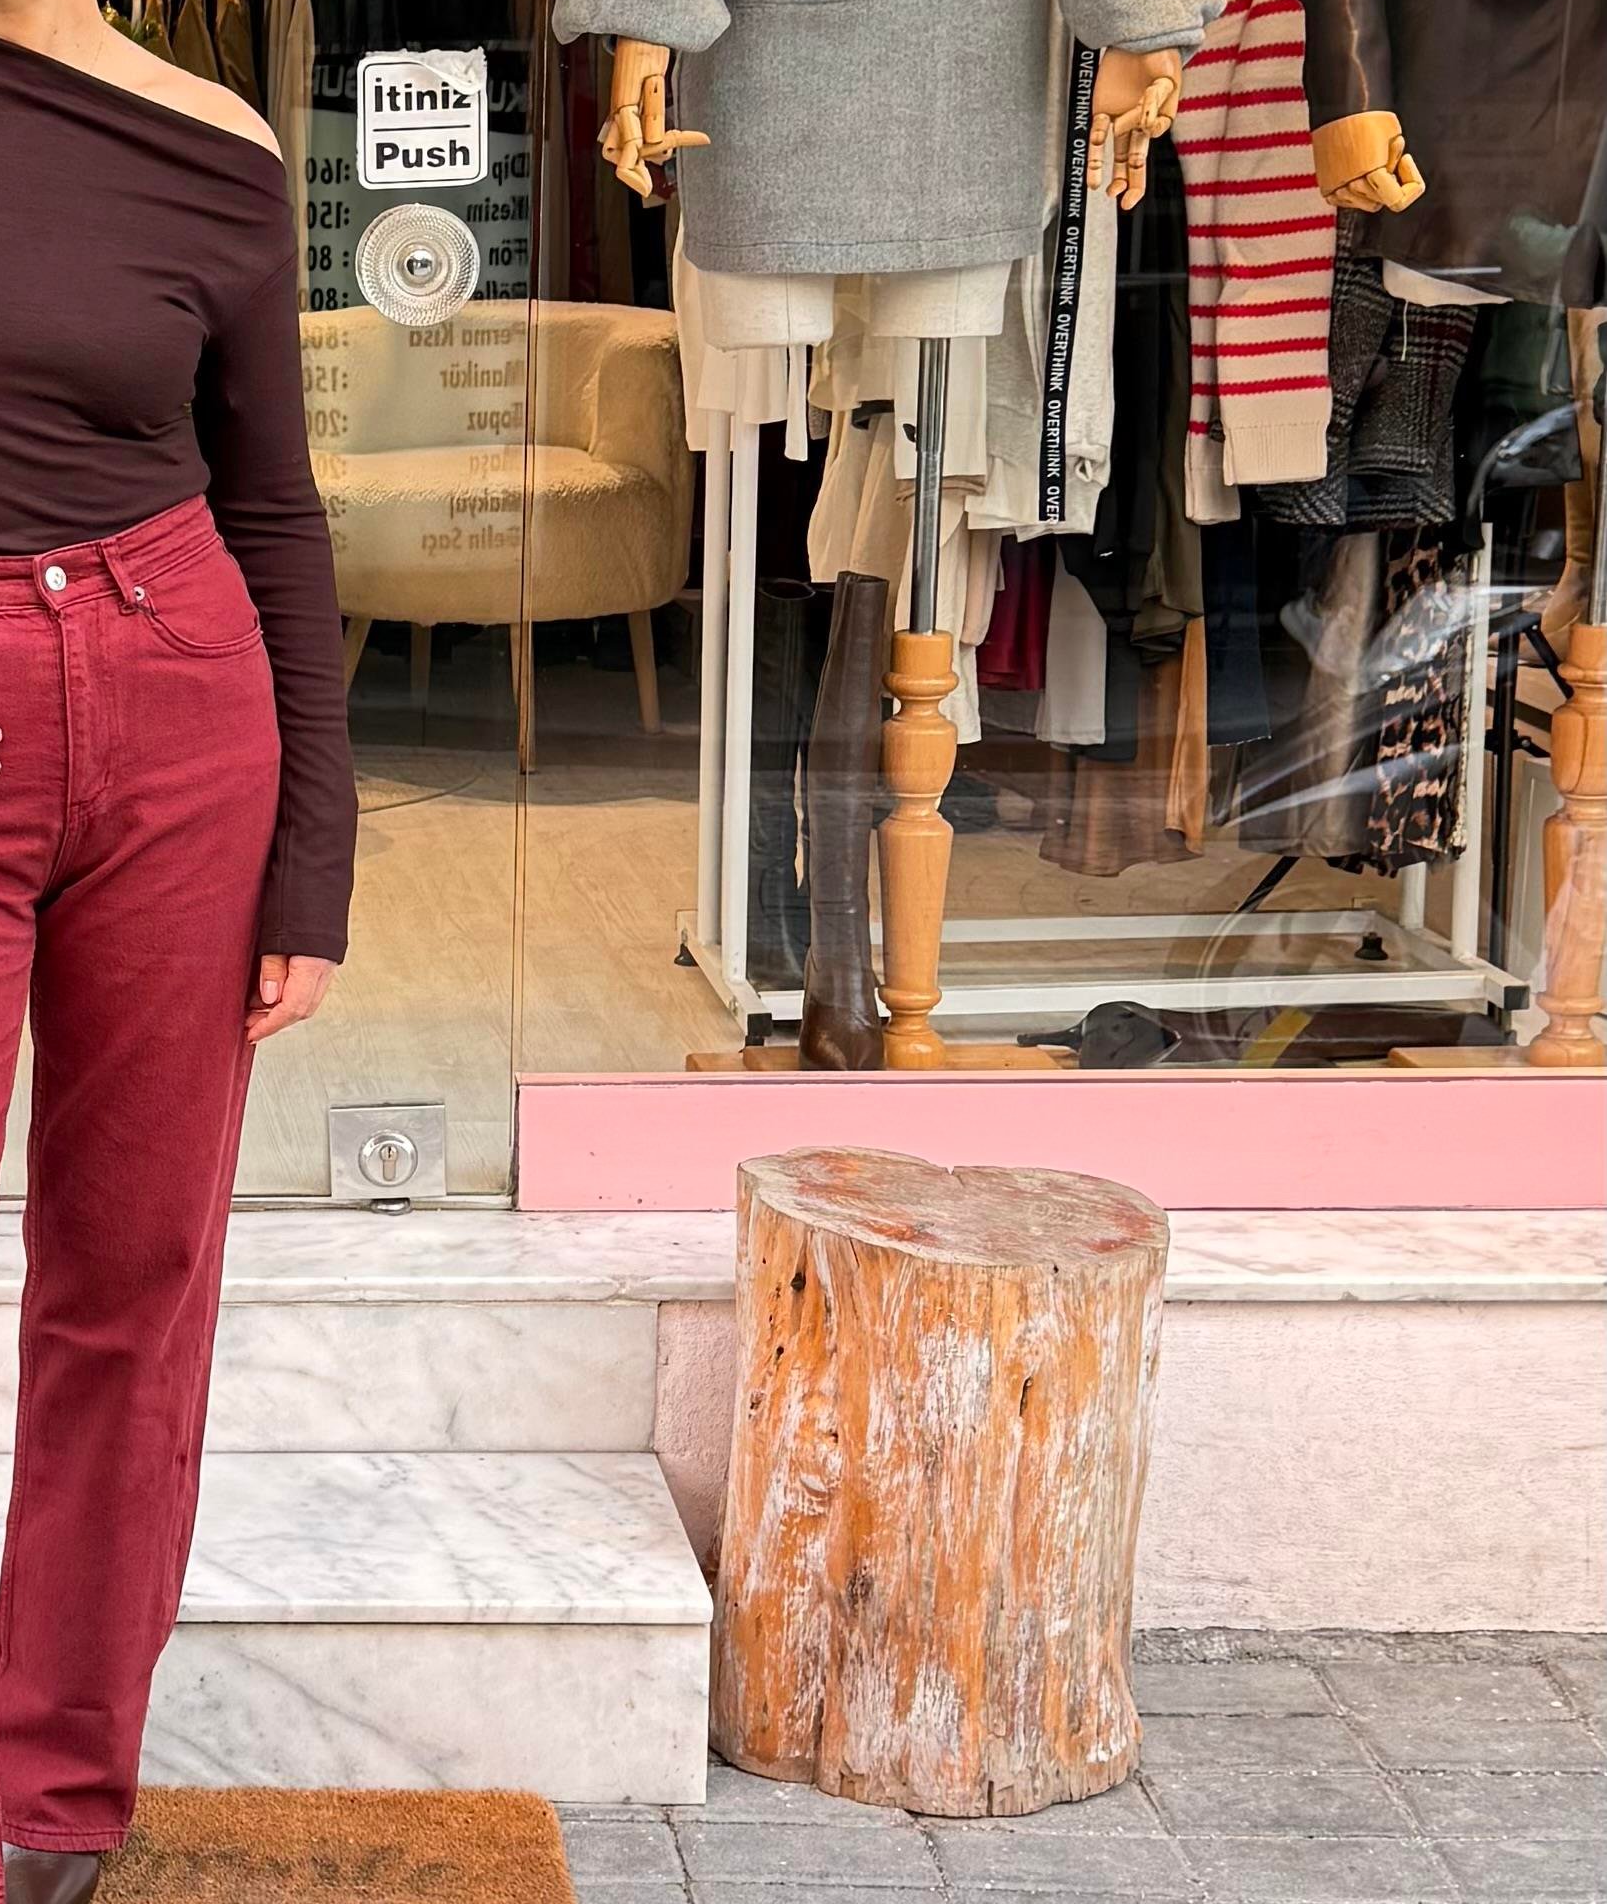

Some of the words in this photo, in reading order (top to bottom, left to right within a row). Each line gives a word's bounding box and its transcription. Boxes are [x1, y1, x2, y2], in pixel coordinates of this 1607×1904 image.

[1073, 50, 1094, 131] OVERTHINK
[375, 139, 470, 170] Push
[1067, 138, 1086, 218] OVERTHINK
[1059, 226, 1080, 306] OVERTHINK
[1049, 313, 1072, 392] OVERTHINK
[1046, 399, 1062, 478] OVERTHINK
